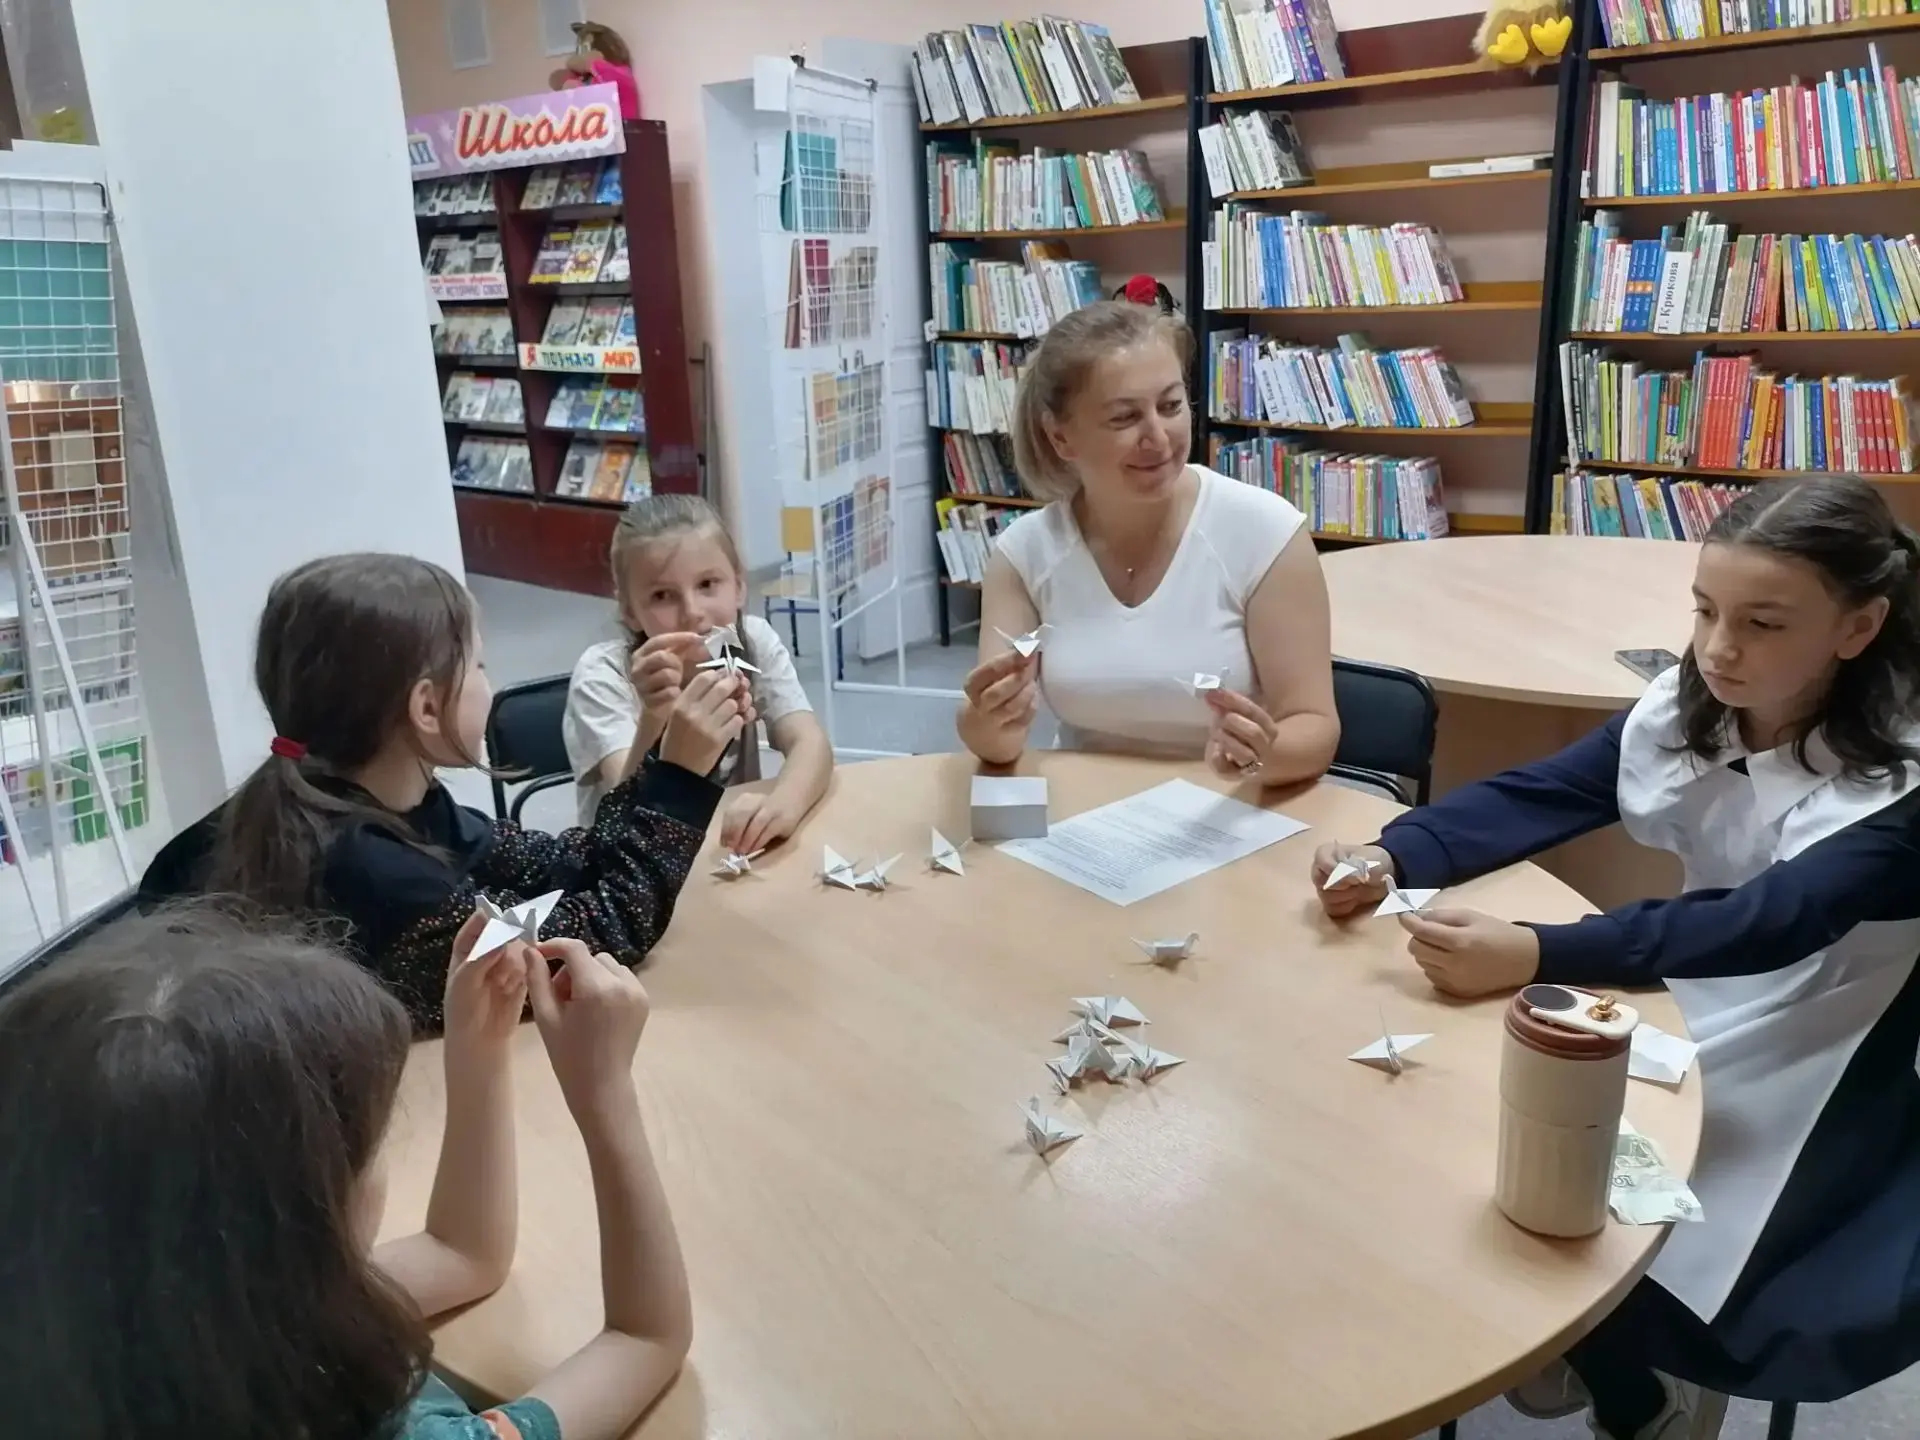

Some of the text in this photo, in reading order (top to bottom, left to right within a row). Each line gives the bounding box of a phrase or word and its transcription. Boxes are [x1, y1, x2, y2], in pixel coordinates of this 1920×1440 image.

[459, 106, 609, 159] Школа
[1657, 262, 1679, 332] Т. Крюкова
[526, 345, 537, 367] Я
